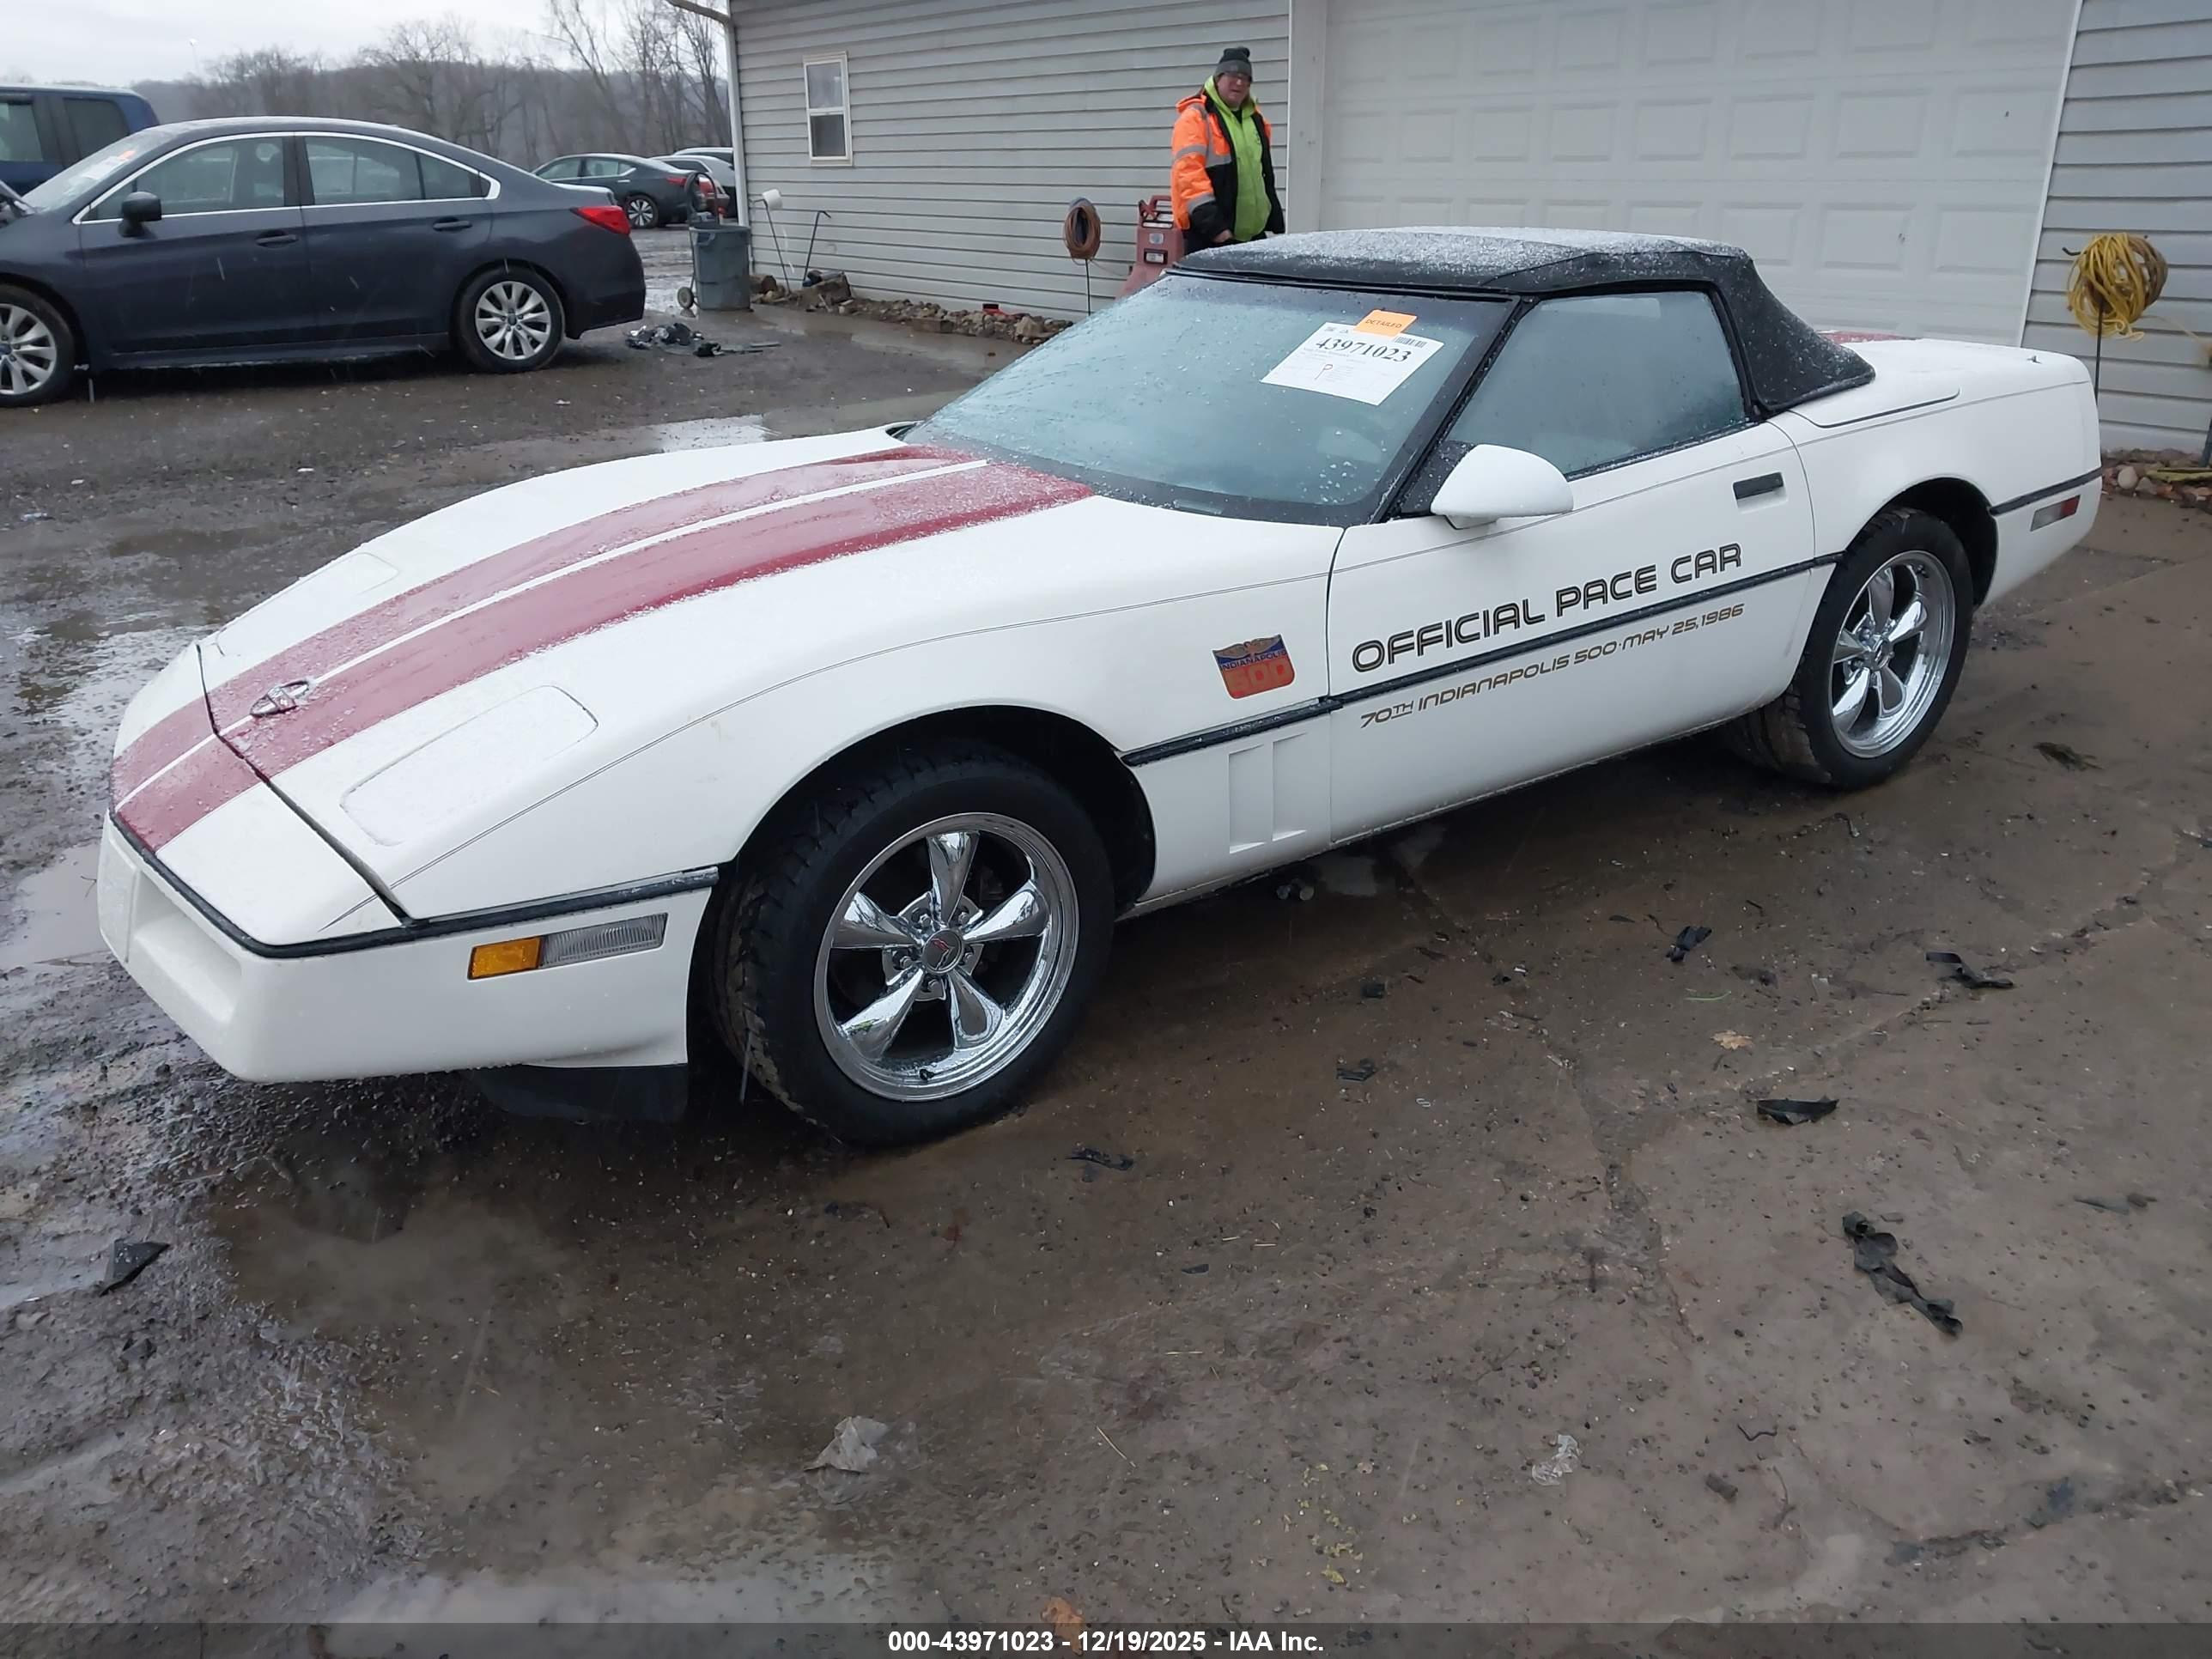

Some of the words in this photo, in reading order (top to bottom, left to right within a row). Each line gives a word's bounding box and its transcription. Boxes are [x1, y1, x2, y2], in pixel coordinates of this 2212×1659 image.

[1316, 337, 1412, 362] 43971023
[1352, 599, 1546, 673] OFFICIAL
[1555, 564, 1657, 617] PACE
[1670, 542, 1742, 584] CAR
[1360, 700, 1413, 729] 70TH
[1419, 654, 1571, 712] INDIANAPOLIS
